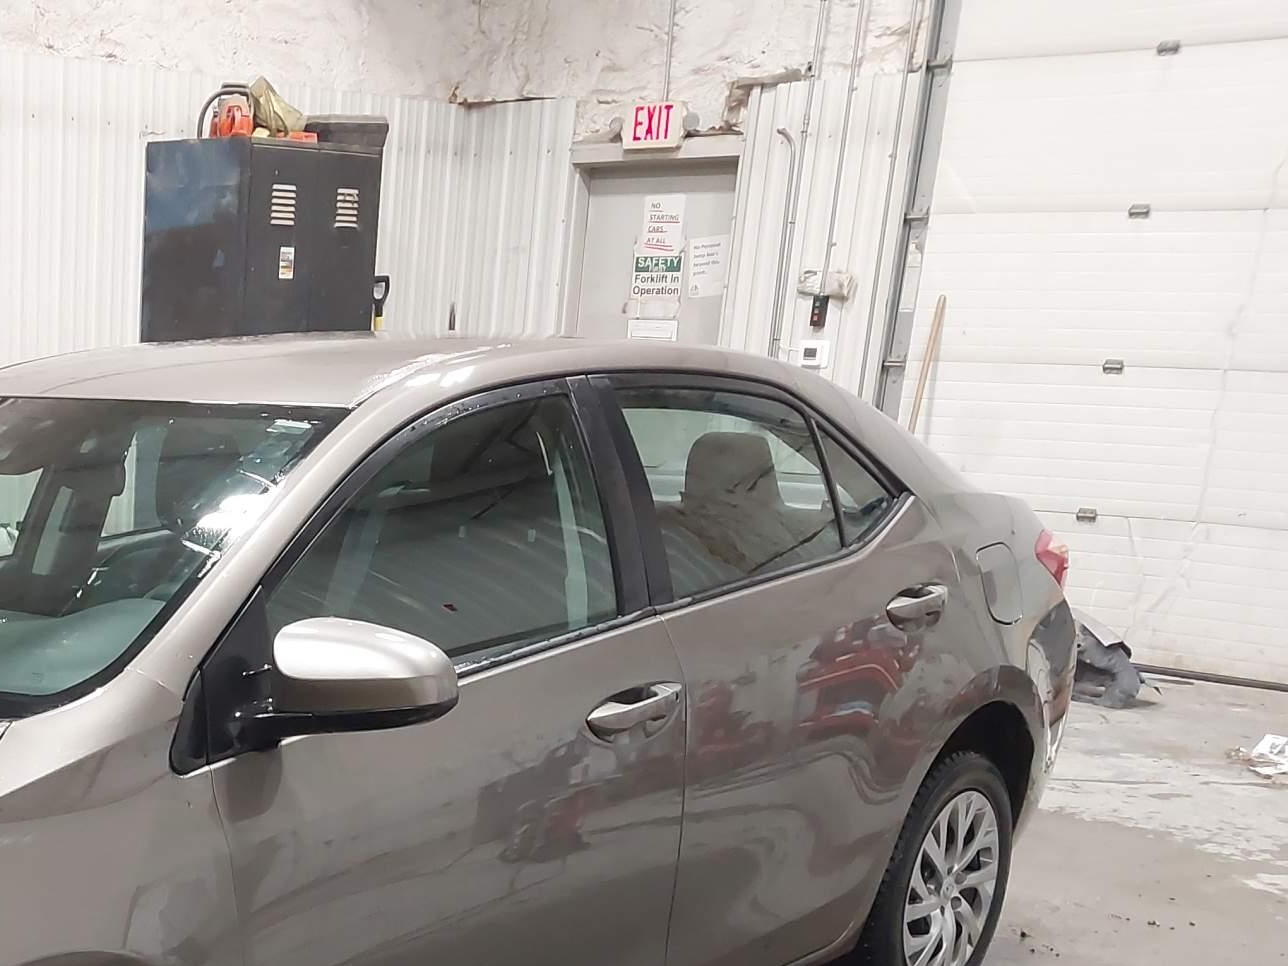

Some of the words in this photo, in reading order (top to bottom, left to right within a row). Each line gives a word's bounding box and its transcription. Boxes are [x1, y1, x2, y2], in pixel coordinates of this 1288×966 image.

[632, 104, 674, 141] EXIT
[637, 257, 680, 268] SAFETY
[634, 274, 668, 284] Forklift
[670, 274, 680, 283] In
[632, 285, 679, 297] Operation
